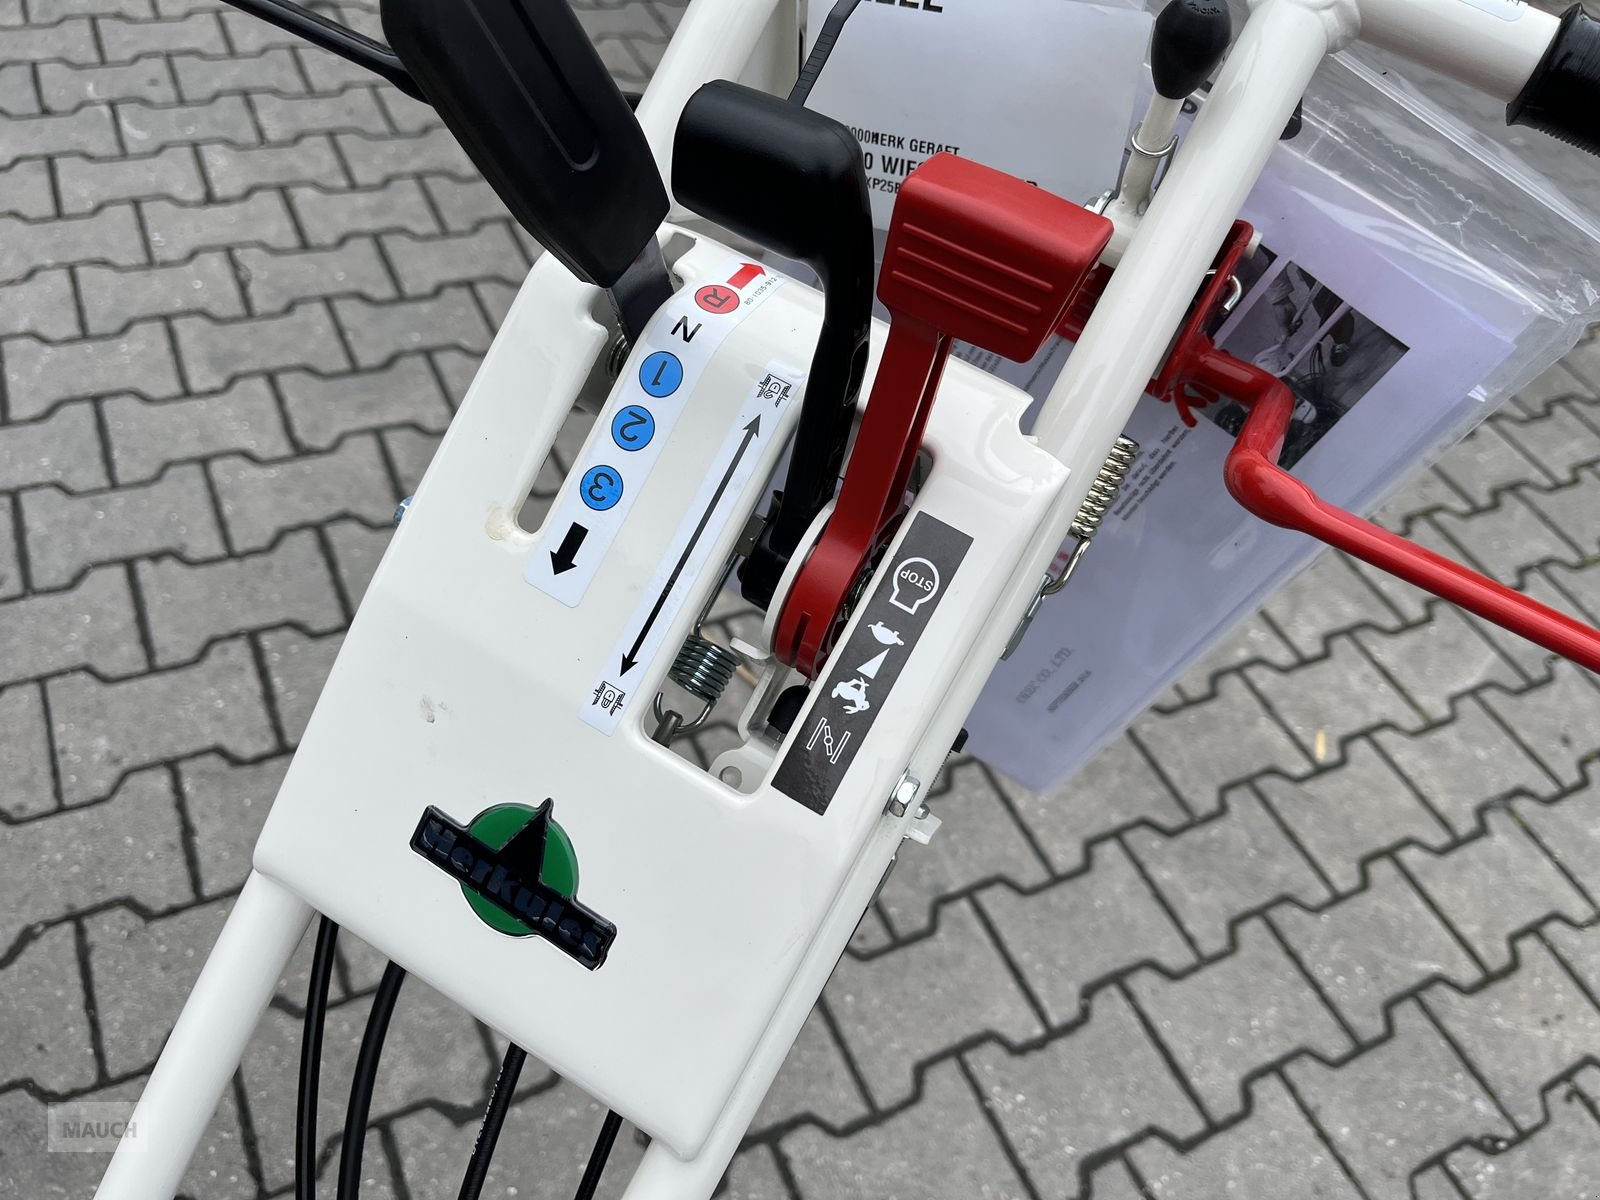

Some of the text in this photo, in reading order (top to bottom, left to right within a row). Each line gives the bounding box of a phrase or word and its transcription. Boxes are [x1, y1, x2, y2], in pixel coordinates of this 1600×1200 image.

[703, 288, 731, 308] R
[671, 315, 702, 343] N
[652, 360, 668, 387] 1
[620, 410, 647, 442] 2
[588, 472, 614, 502] 3
[900, 569, 934, 592] STOP
